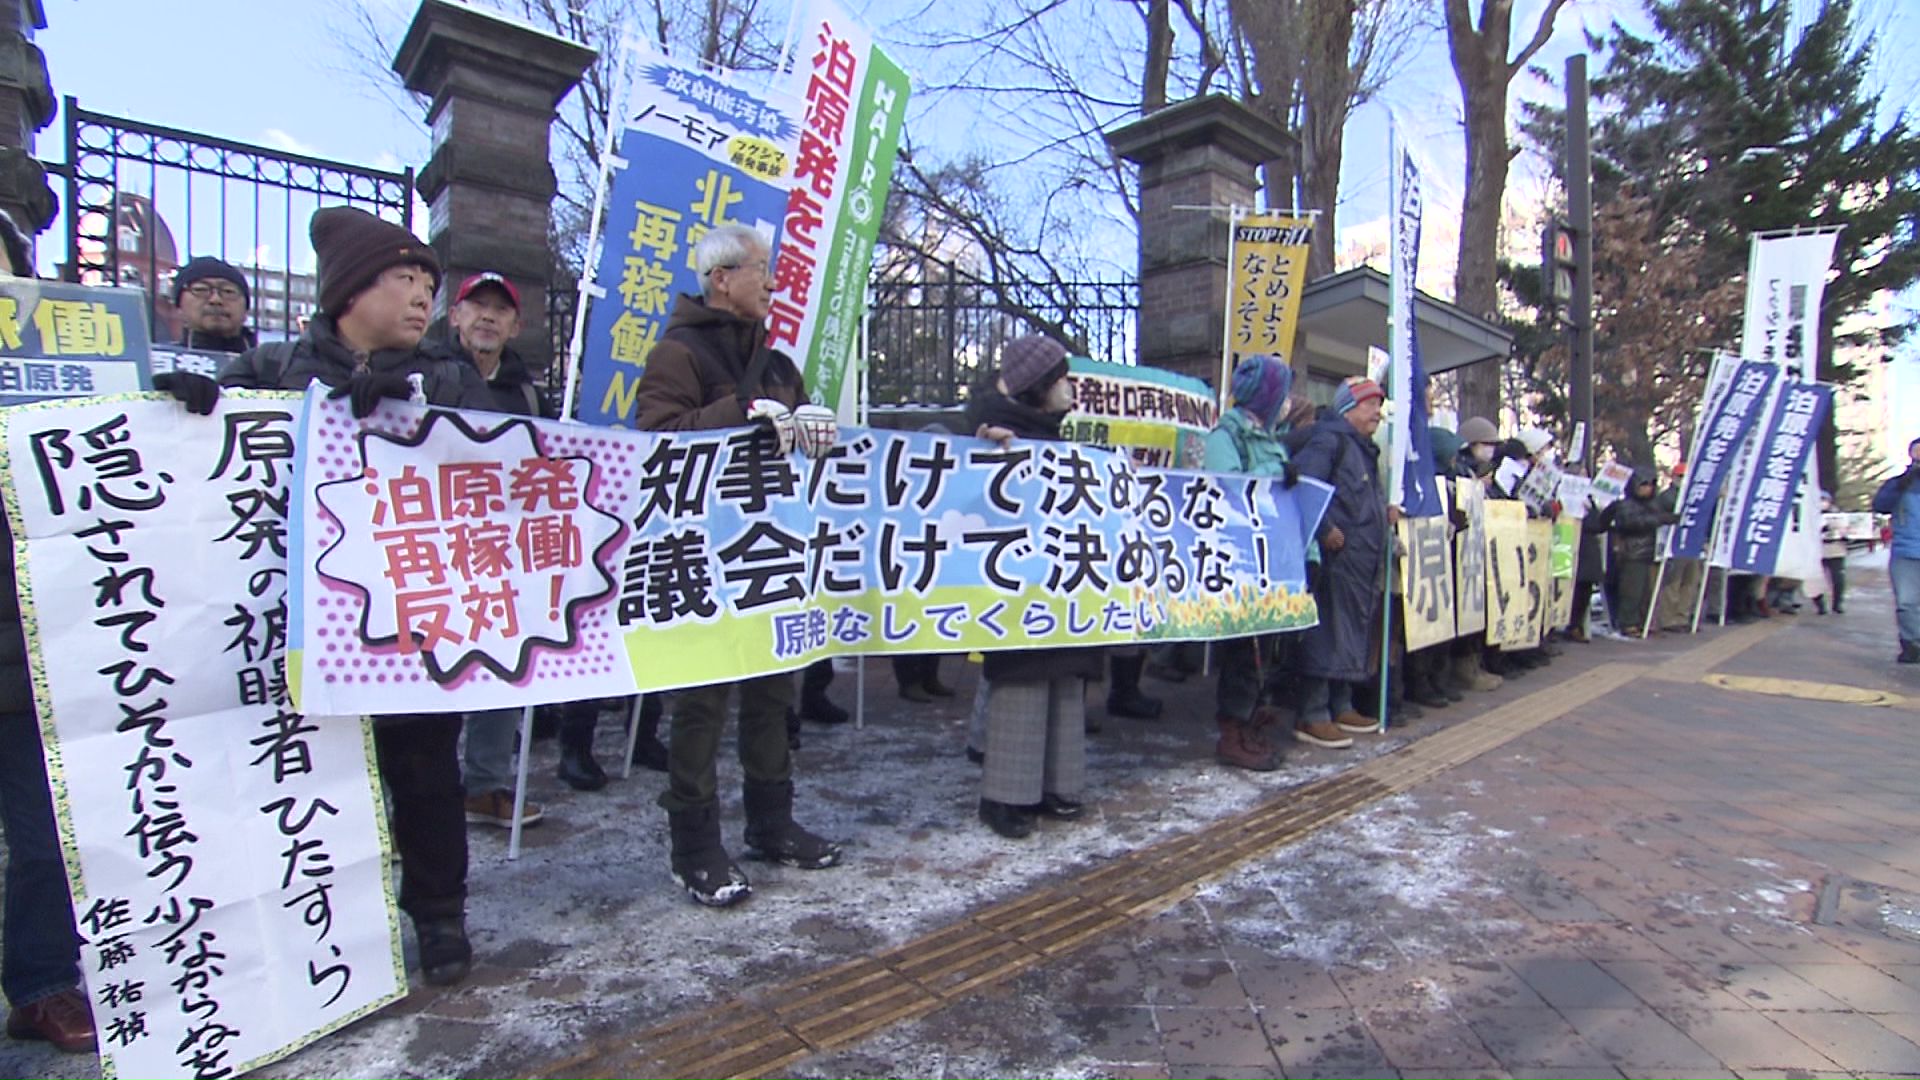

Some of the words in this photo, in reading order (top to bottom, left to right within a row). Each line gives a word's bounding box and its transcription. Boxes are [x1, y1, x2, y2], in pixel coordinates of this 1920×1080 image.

[633, 104, 729, 149] ノーモア
[665, 70, 781, 135] 放射能汚染
[736, 140, 786, 162] フクシマ
[0, 298, 125, 356] 働
[600, 199, 682, 430] 再稼働N
[1237, 253, 1266, 344] なくそう
[1261, 254, 1290, 345] とめよう
[363, 457, 579, 528] 泊原発
[633, 436, 1259, 531] 知事だけで決めるな!
[372, 513, 583, 590] 再稼働
[617, 518, 1270, 626] 議会だけで決めるな!
[394, 574, 567, 655] 反対!
[774, 601, 1168, 656] 原発なしでくらしたい
